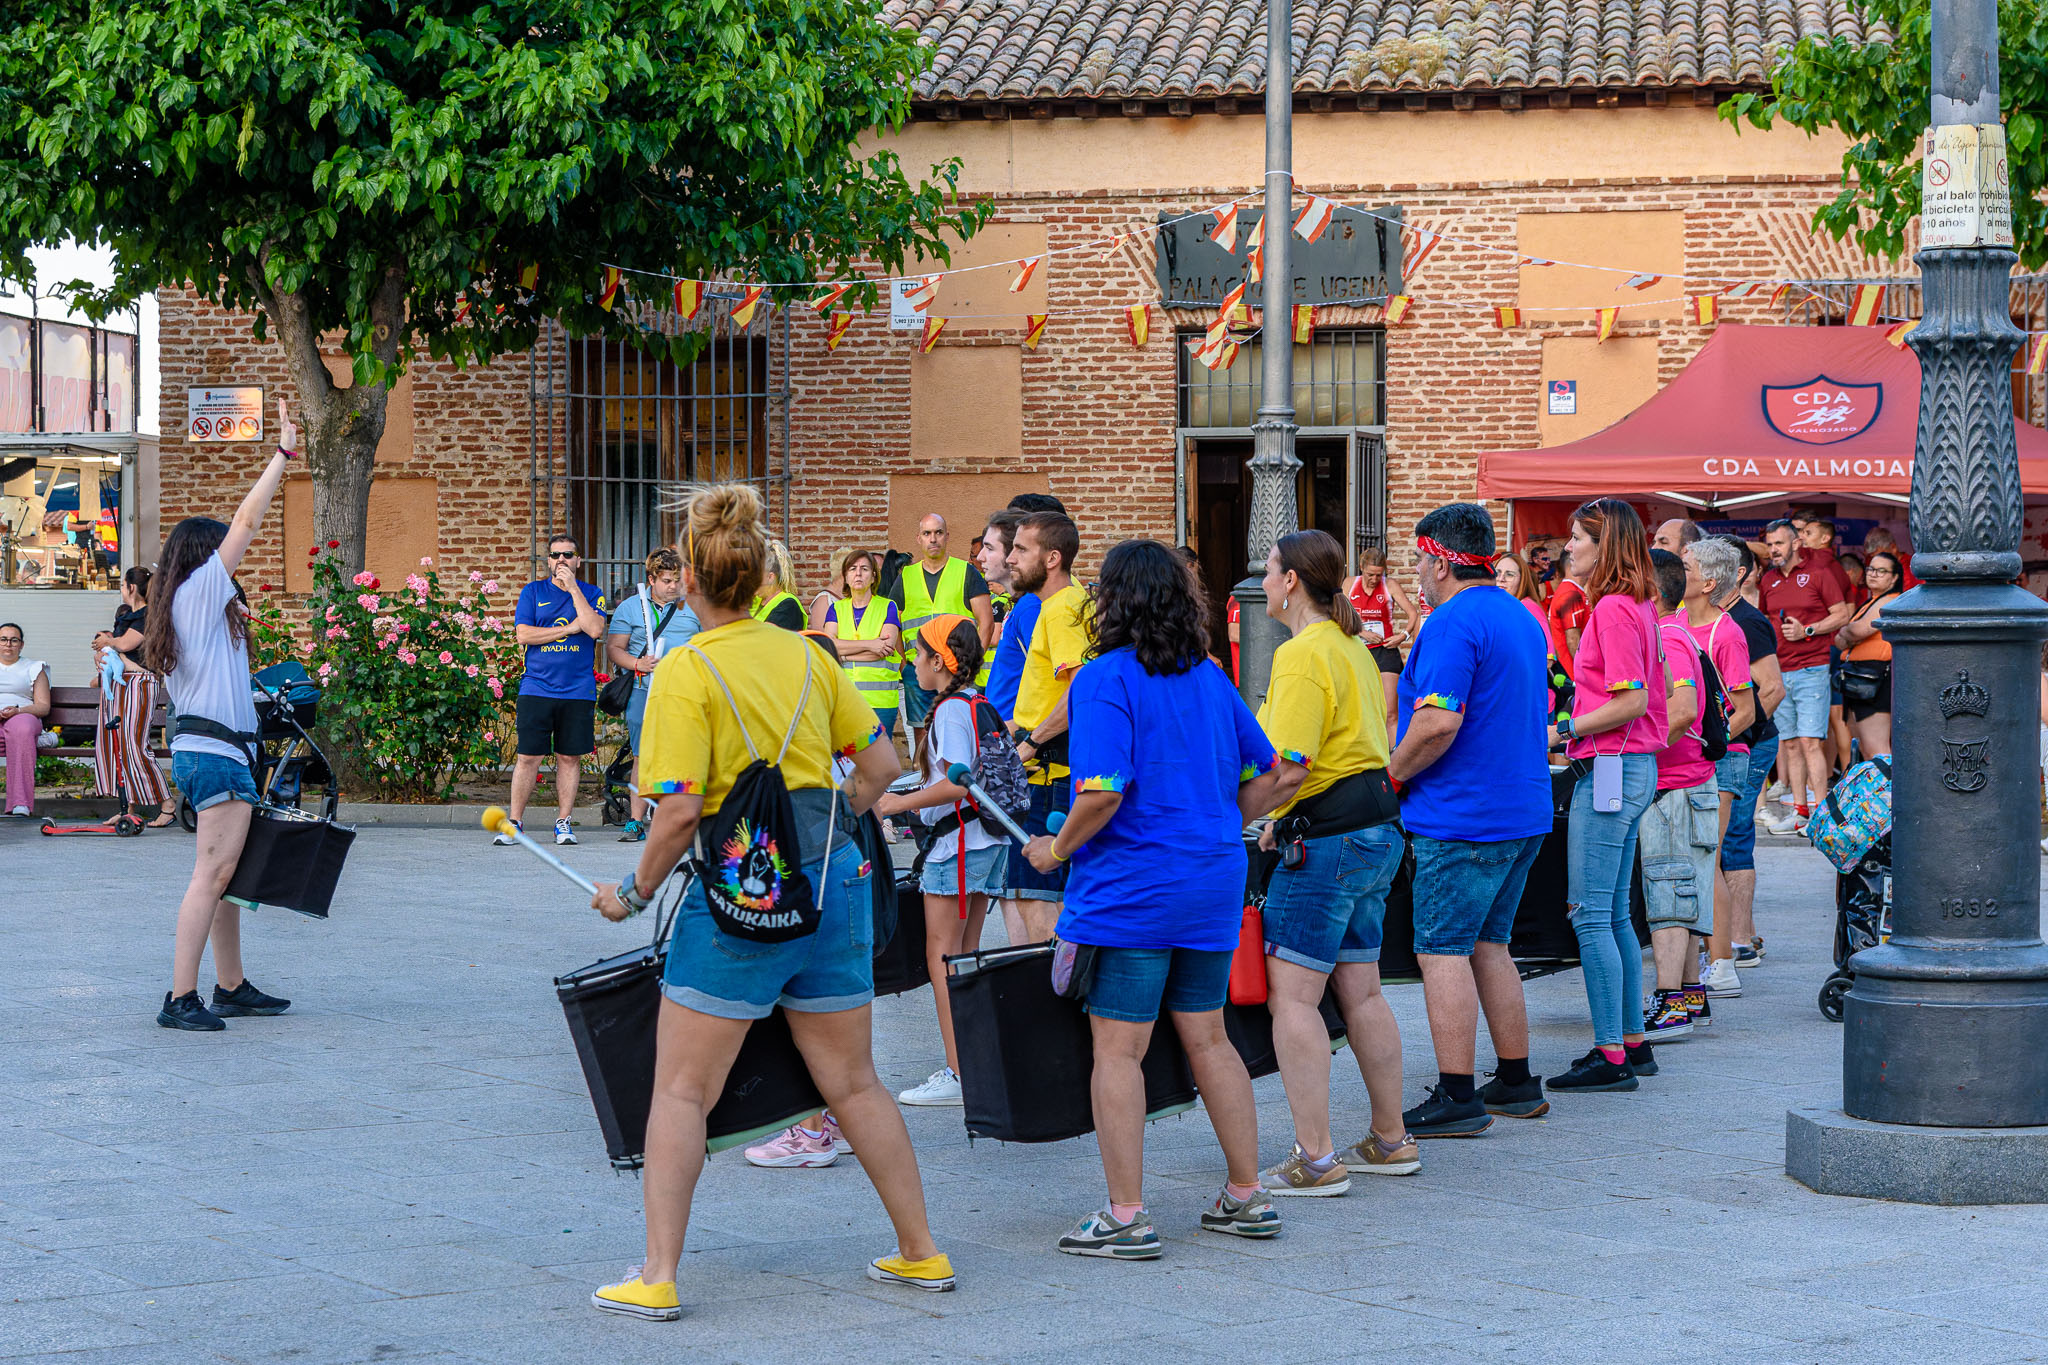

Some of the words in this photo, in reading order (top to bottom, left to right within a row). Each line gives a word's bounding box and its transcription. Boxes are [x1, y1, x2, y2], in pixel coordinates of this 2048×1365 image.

[1936, 191, 1946, 200] al
[1929, 205, 1974, 214] bicicleta
[1927, 219, 1936, 228] 10
[1938, 218, 1966, 228] años
[1320, 275, 1389, 298] UGENA
[1792, 391, 1852, 405] CDA
[1787, 426, 1858, 434] VALMOJADO
[1703, 458, 1760, 476] CDA
[1940, 897, 1999, 919] 1832
